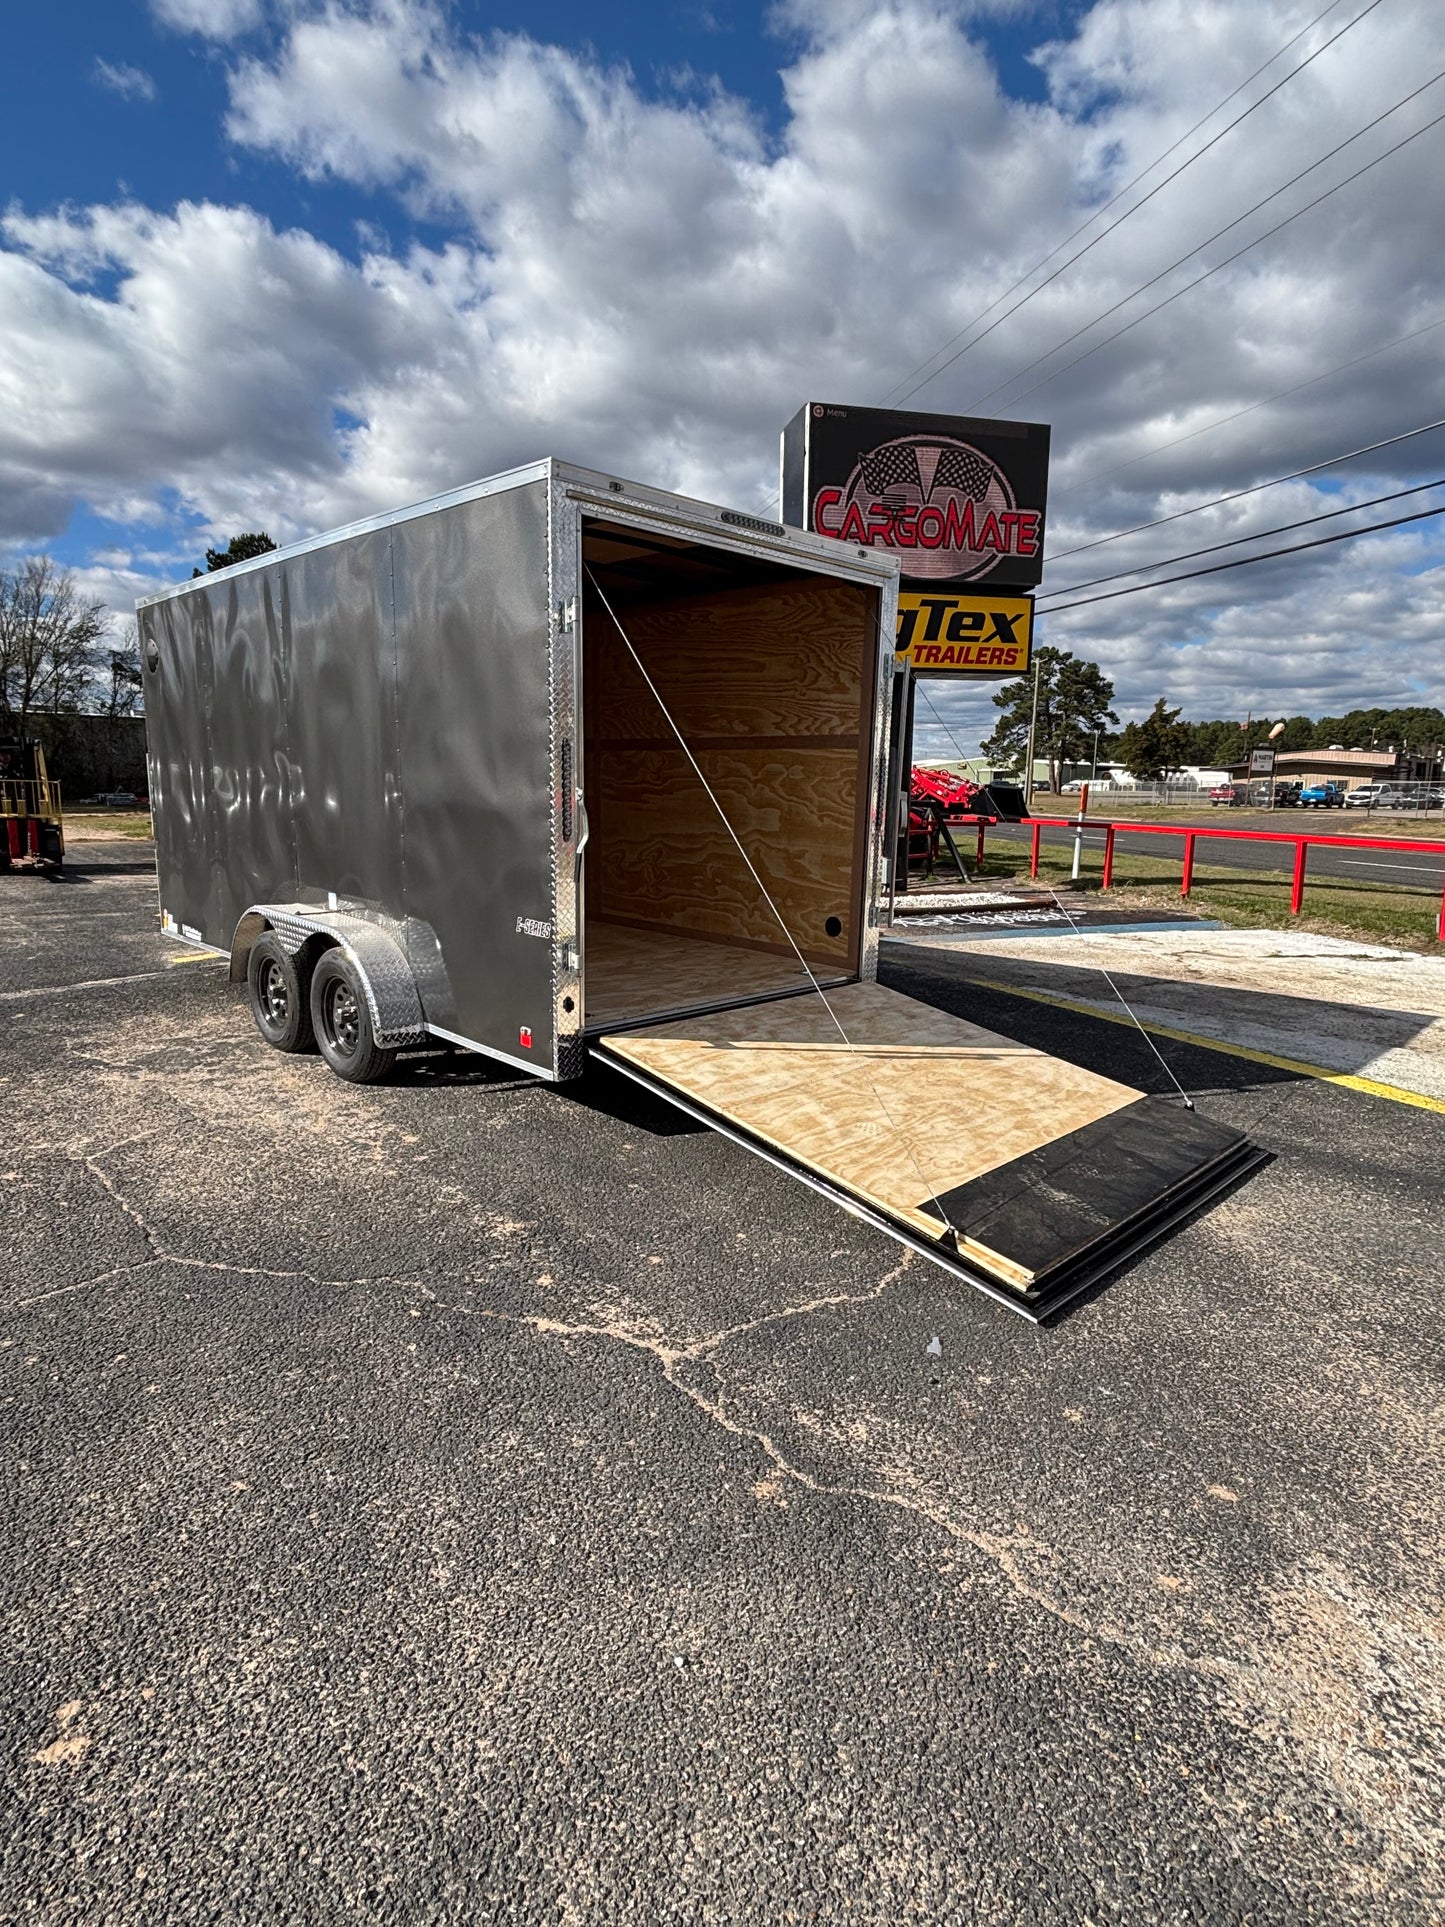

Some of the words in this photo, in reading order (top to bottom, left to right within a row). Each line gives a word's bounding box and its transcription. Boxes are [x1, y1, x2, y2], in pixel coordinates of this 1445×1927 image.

[826, 408, 848, 418] Menu
[913, 644, 1019, 666] TRAILERS
[515, 916, 552, 939] E-SERIES
